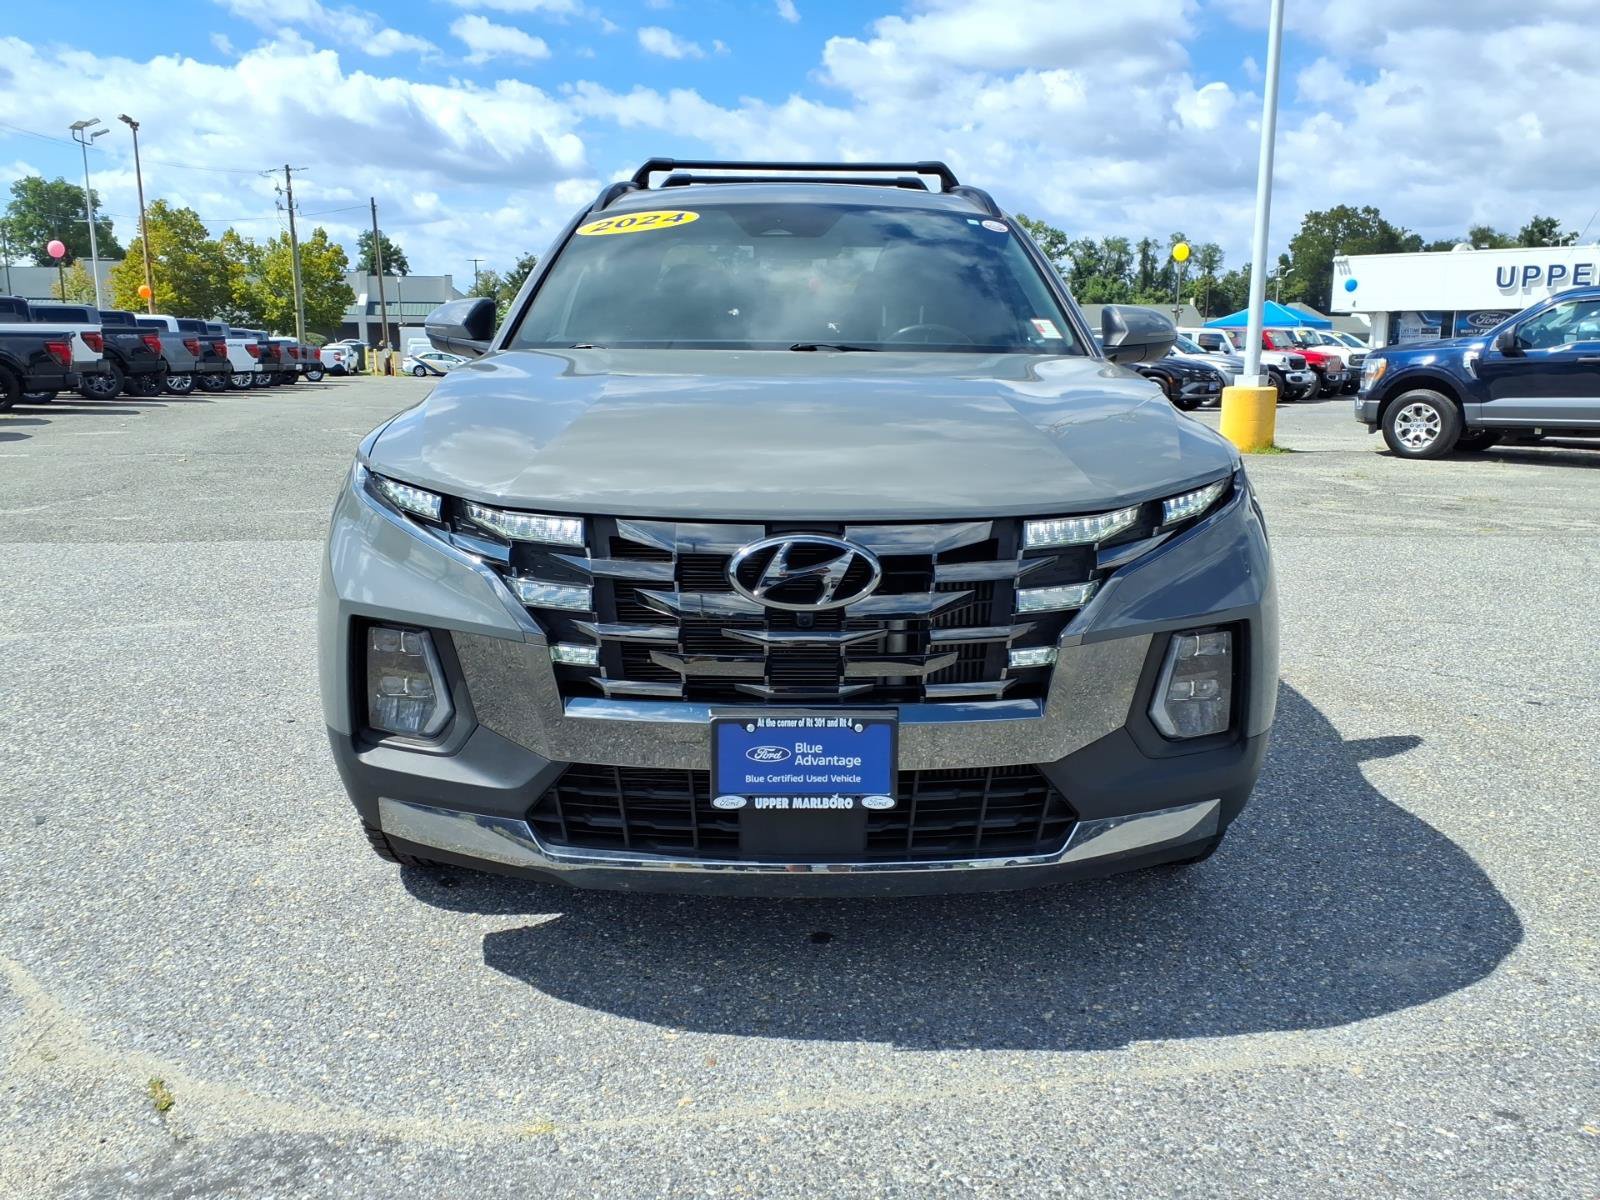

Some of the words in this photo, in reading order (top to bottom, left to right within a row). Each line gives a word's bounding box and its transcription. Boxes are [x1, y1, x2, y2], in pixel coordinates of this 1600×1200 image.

[590, 213, 684, 232] 2024
[1496, 263, 1600, 288] UPPE
[757, 718, 766, 728] At
[767, 718, 775, 728] the
[777, 719, 795, 728] corner
[798, 718, 804, 728] of
[806, 718, 813, 728] Rt
[814, 718, 825, 728] 301
[827, 718, 838, 728] and
[839, 718, 846, 728] Rt
[847, 718, 852, 728] 4
[754, 747, 783, 760] Ford
[795, 743, 823, 753] Blue
[795, 755, 862, 768] Advantage
[745, 775, 765, 783] Blue
[767, 775, 804, 783] Certified
[806, 775, 828, 783] Used
[831, 775, 861, 783] Vehicle
[755, 798, 789, 809] UPPER
[792, 796, 854, 809] MARLBORO
